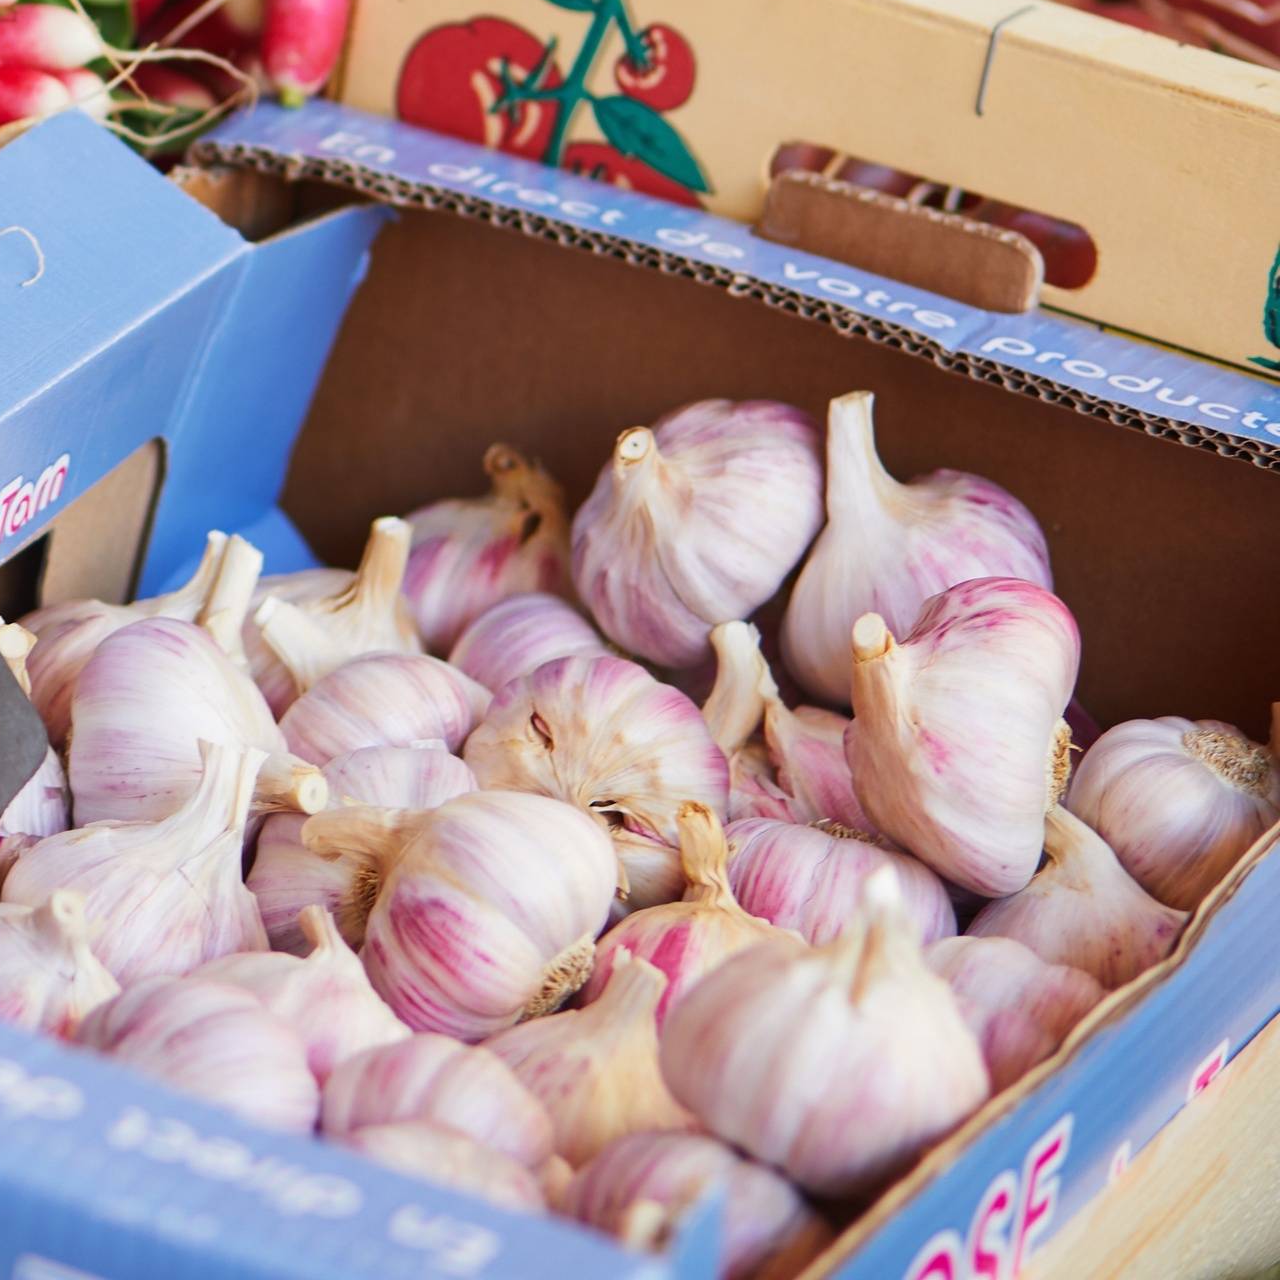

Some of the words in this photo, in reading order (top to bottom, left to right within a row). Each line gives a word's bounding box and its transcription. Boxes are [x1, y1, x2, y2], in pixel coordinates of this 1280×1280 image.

[317, 130, 396, 165] En
[427, 158, 628, 226] direct
[655, 226, 746, 261] de
[782, 261, 957, 331] votre
